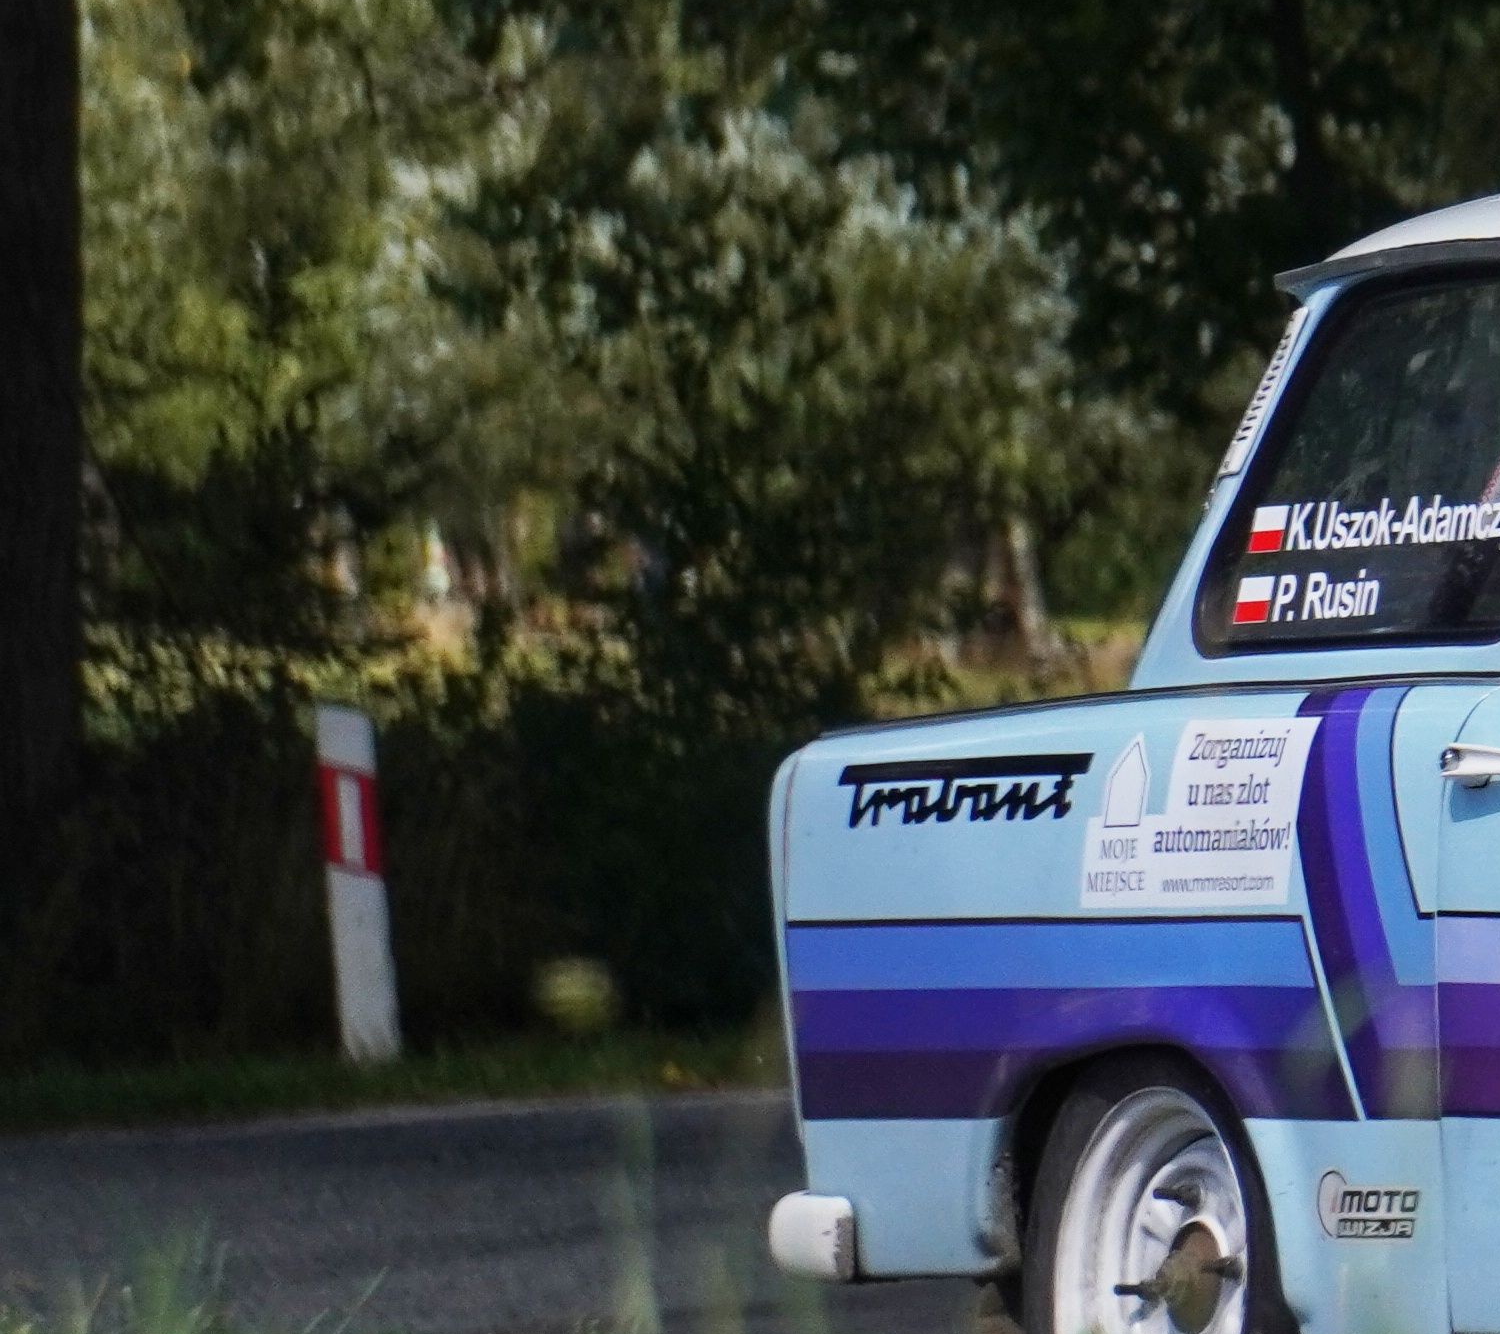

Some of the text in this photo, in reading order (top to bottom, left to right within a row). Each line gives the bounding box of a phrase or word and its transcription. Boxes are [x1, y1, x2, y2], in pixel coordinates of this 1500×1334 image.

[1271, 568, 1380, 622] P. Rusin
[1188, 729, 1291, 768] Zorganizuj
[838, 753, 1094, 829] Trabant
[1187, 776, 1271, 806] u nas zlot
[1099, 837, 1138, 861] MOJE
[1153, 820, 1291, 854] automaniaków!
[1086, 870, 1145, 896] MIEJSCE
[1339, 1190, 1420, 1213] MOTO
